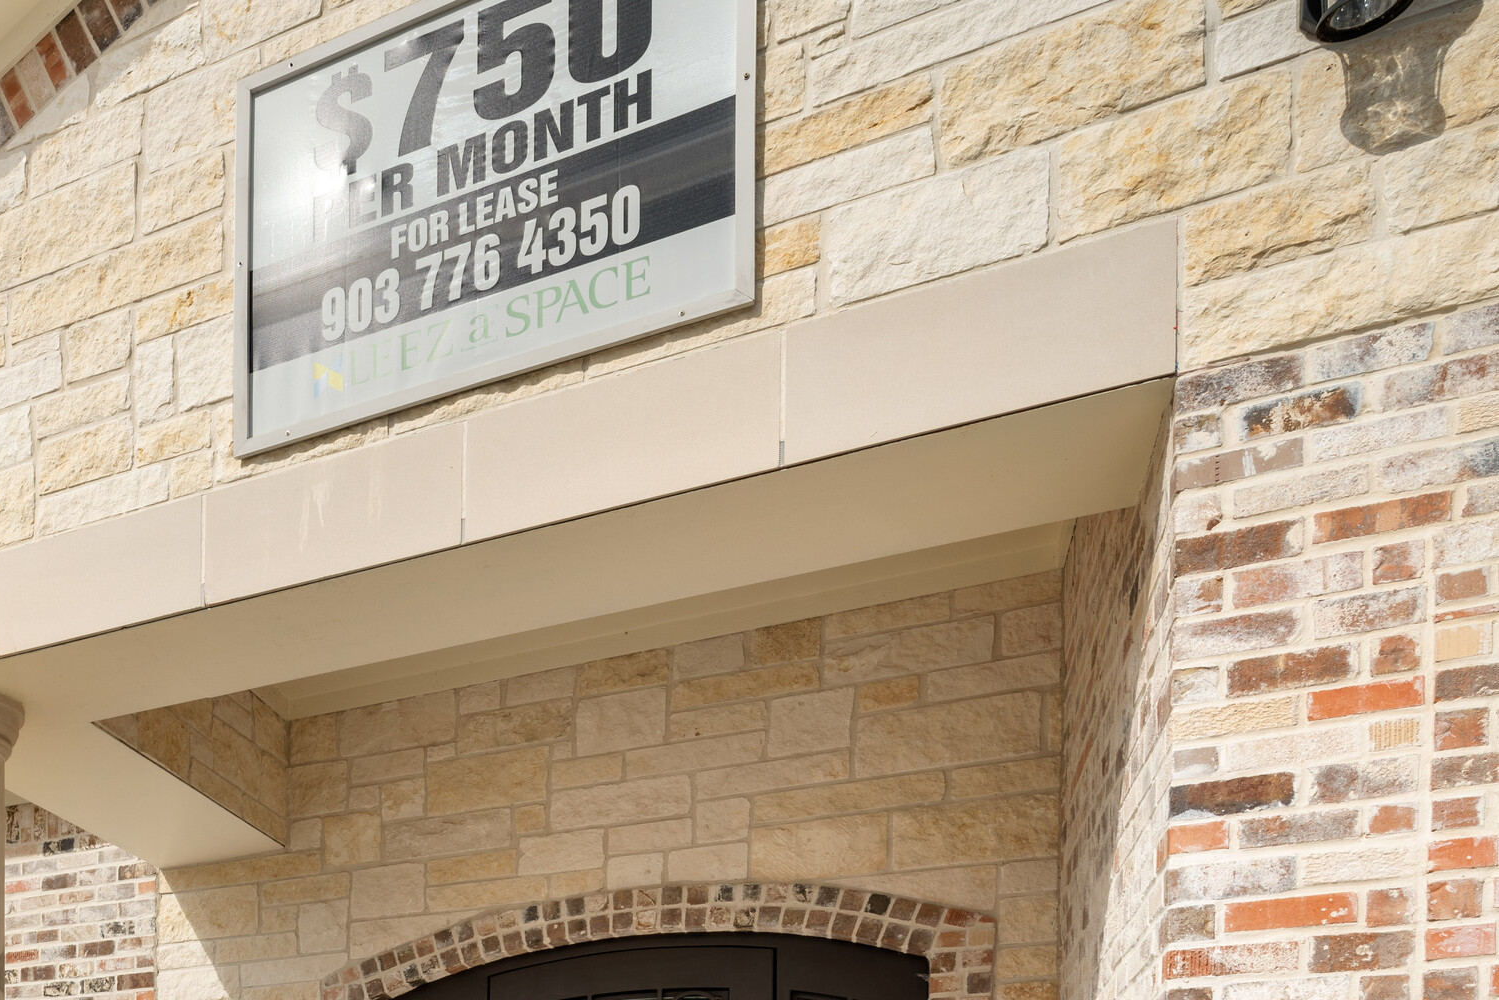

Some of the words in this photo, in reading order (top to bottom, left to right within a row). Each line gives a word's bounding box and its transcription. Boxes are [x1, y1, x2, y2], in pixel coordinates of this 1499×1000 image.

[313, 164, 414, 242] PER
[436, 69, 653, 198] MONTH
[315, 0, 653, 174] $750
[321, 268, 400, 342] 903
[415, 233, 500, 312] 776
[516, 184, 642, 275] 4350
[390, 208, 449, 259] FOR
[459, 170, 559, 234] LEASE
[350, 319, 453, 386] LEEZ
[504, 256, 652, 336] SPACE
